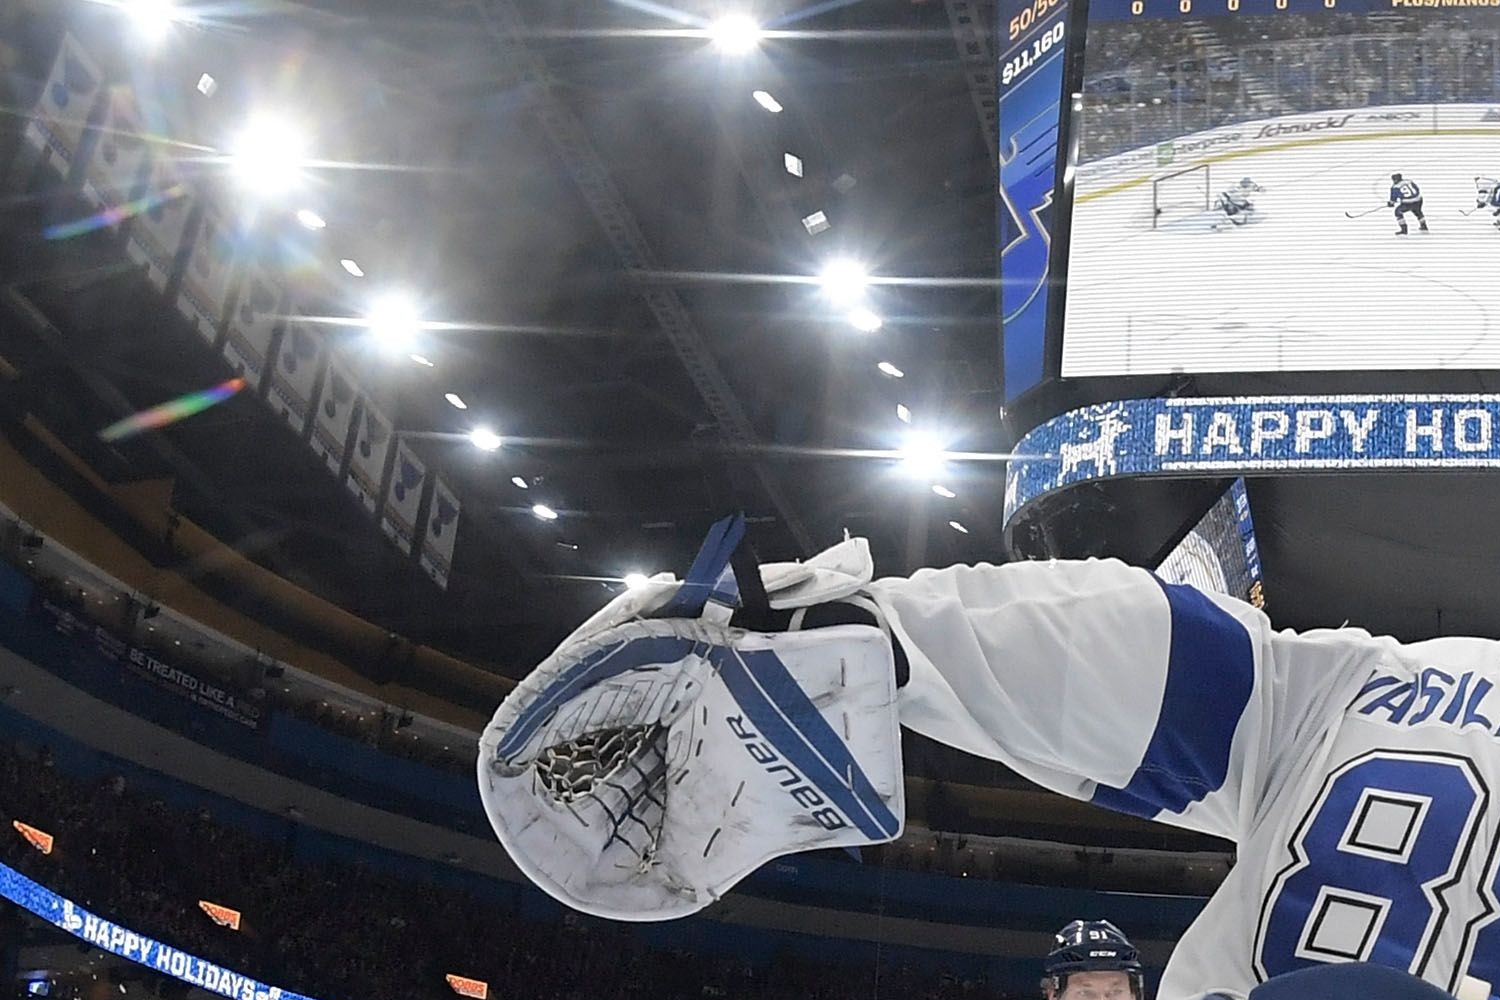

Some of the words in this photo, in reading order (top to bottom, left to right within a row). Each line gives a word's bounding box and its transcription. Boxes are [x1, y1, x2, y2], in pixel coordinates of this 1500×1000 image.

[1002, 21, 1064, 85] $11,160
[1154, 409, 1378, 456] HAPPY
[146, 656, 198, 691] TREATED
[84, 915, 154, 964] HAPPY
[1089, 930, 1108, 940] 91
